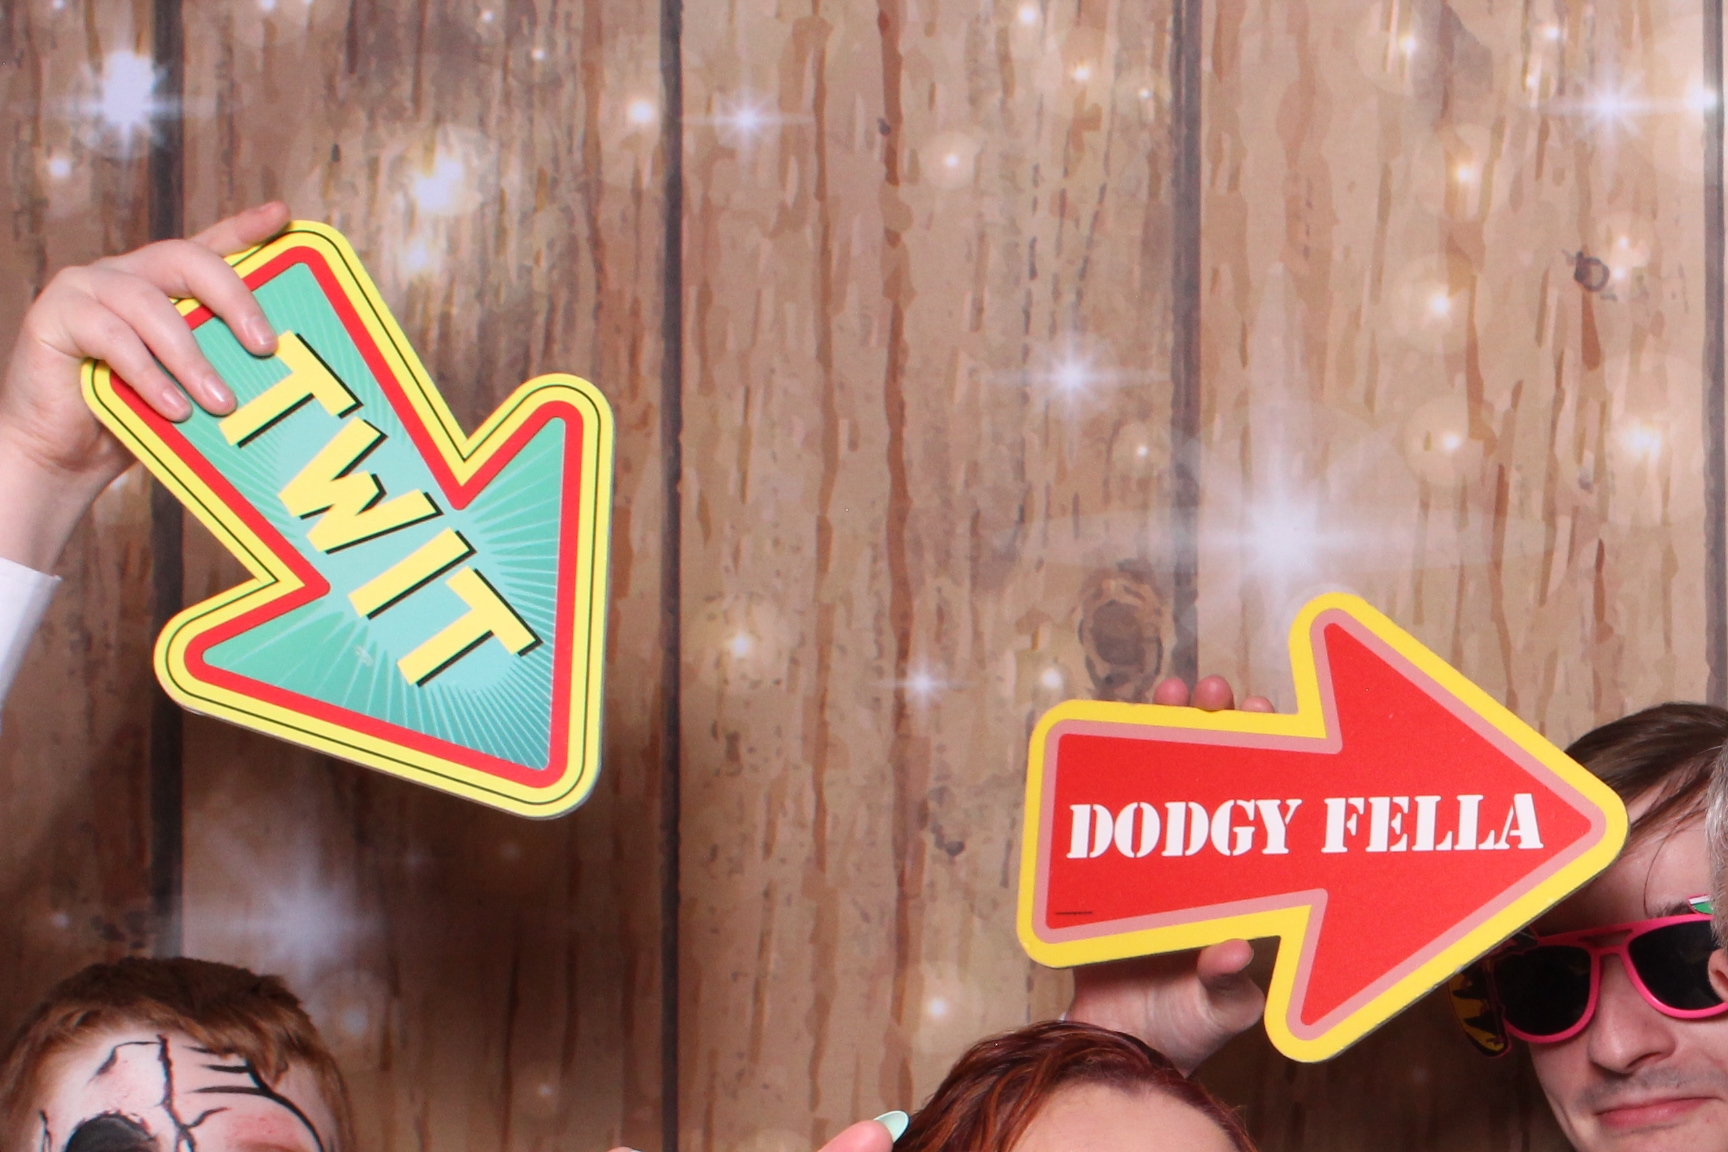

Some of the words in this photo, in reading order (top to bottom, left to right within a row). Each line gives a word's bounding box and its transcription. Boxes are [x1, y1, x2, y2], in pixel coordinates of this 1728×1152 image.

[219, 330, 543, 687] TWIT
[1066, 798, 1302, 859] DODGY
[1321, 793, 1544, 853] FELLA
